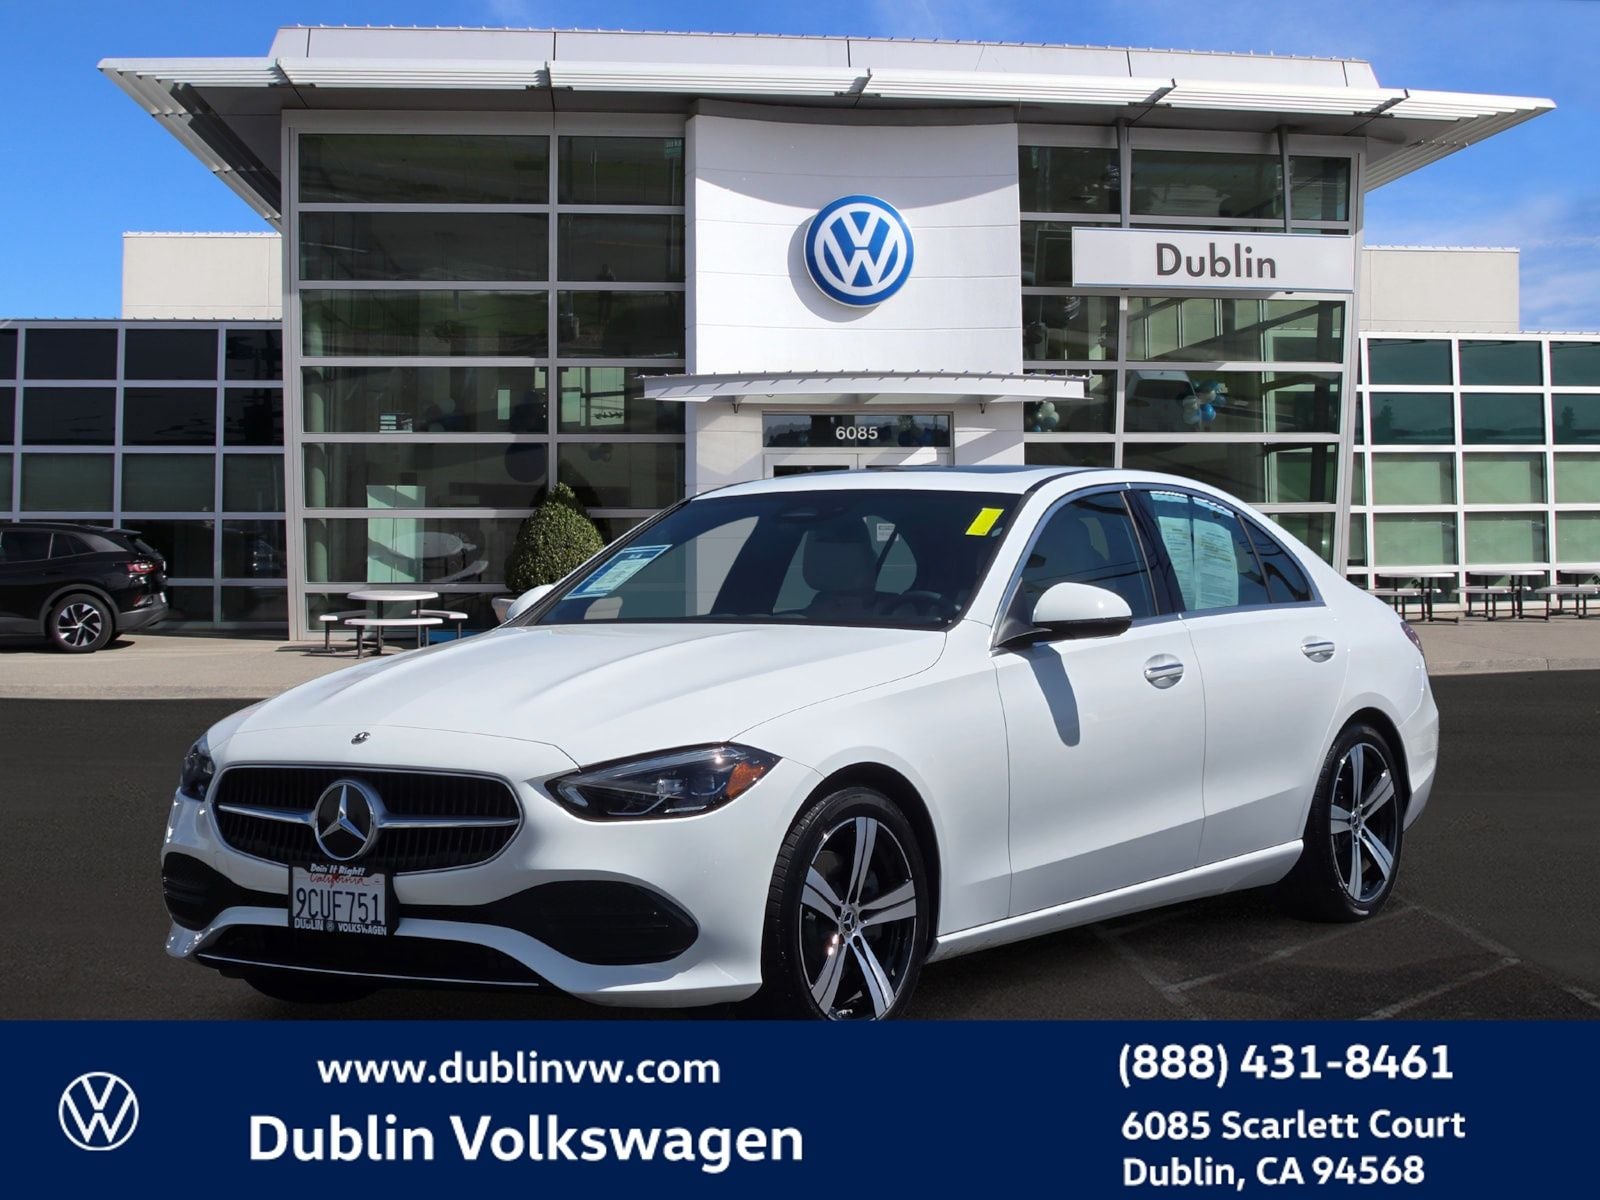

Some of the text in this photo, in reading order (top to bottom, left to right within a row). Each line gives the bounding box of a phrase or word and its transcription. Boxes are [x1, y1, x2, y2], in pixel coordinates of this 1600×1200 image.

[1155, 241, 1278, 280] Dublin
[835, 425, 879, 441] 6085
[329, 864, 338, 873] It
[295, 887, 382, 924] 9CUF751
[294, 918, 387, 936] DUBLIN VOLKSWAGEN
